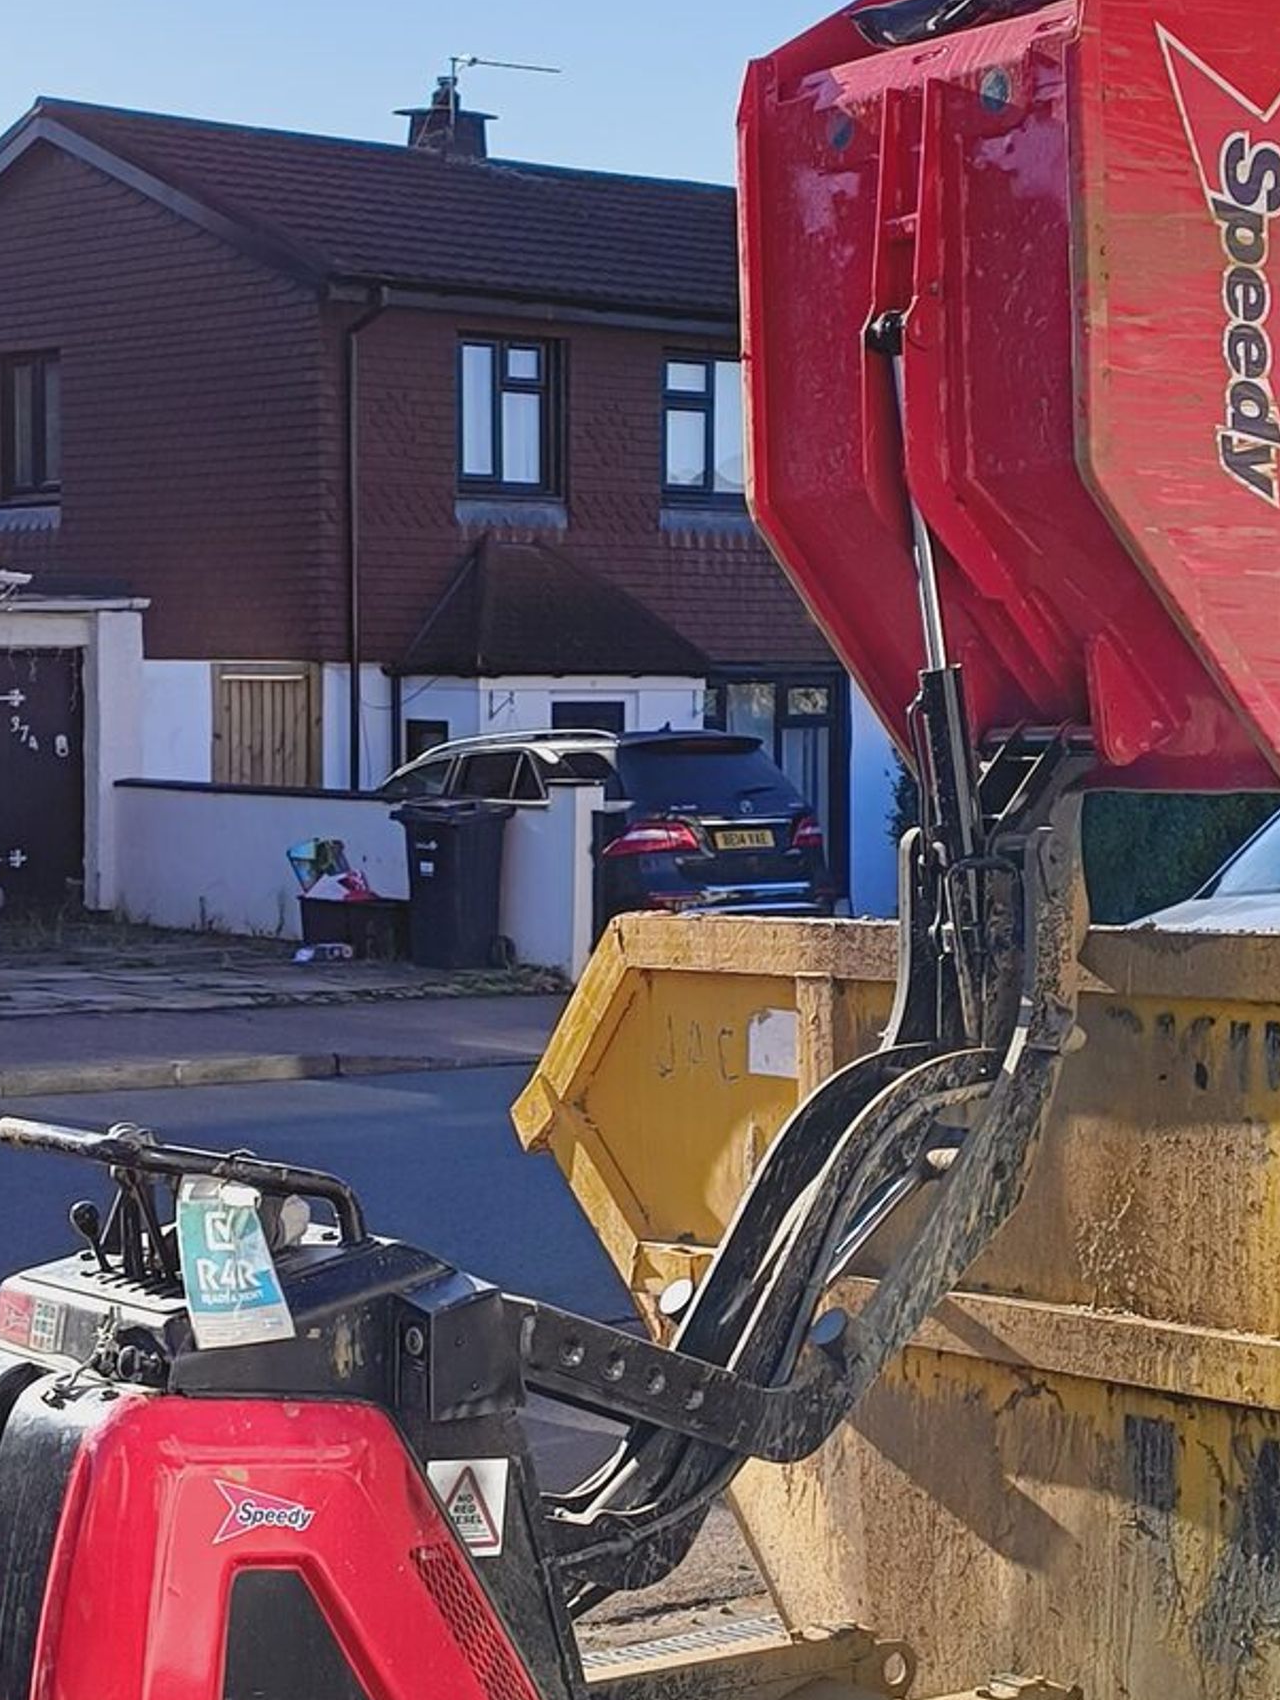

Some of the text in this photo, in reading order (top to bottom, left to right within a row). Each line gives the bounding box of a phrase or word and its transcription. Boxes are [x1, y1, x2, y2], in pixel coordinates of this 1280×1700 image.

[196, 1256, 263, 1292] R4R
[238, 1500, 312, 1530] Speedy
[453, 1504, 477, 1515] RED
